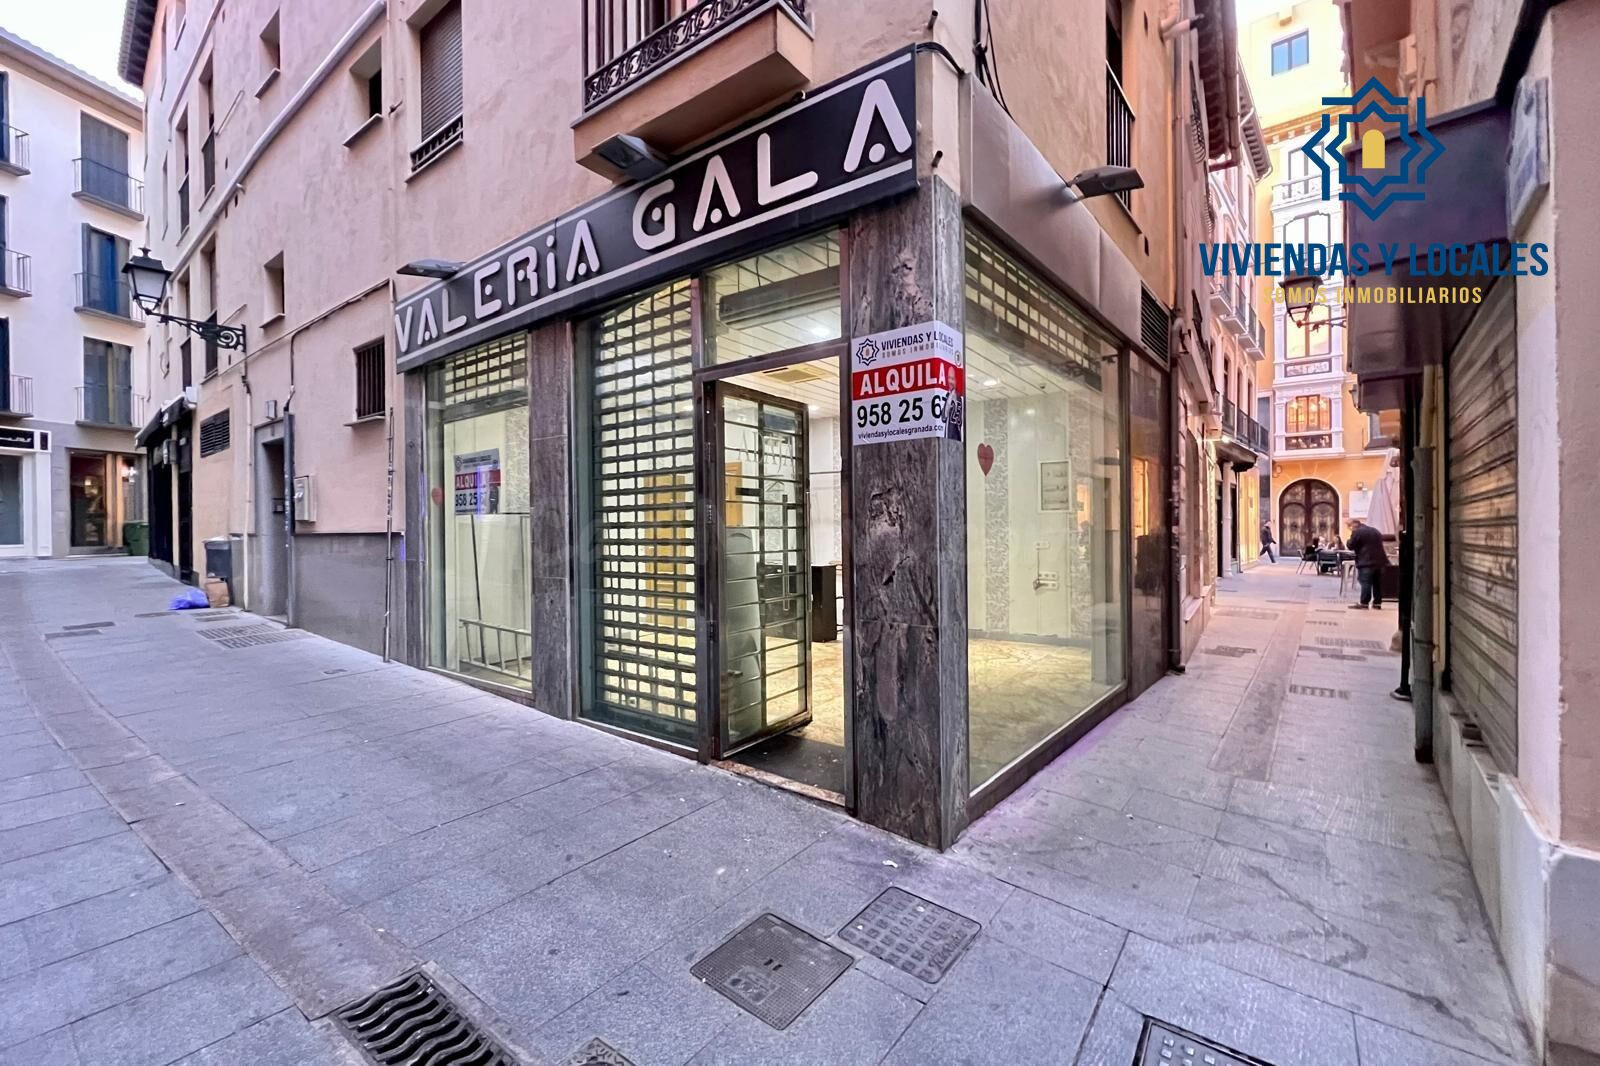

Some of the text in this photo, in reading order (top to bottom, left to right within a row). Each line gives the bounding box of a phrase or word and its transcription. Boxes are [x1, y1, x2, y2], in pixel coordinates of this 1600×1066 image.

[632, 78, 913, 250] GALA
[881, 333, 924, 351] VIVIENDAS
[925, 330, 932, 342] Y
[860, 362, 947, 396] ALQUILA
[857, 402, 892, 428] 958
[898, 397, 924, 422] 25
